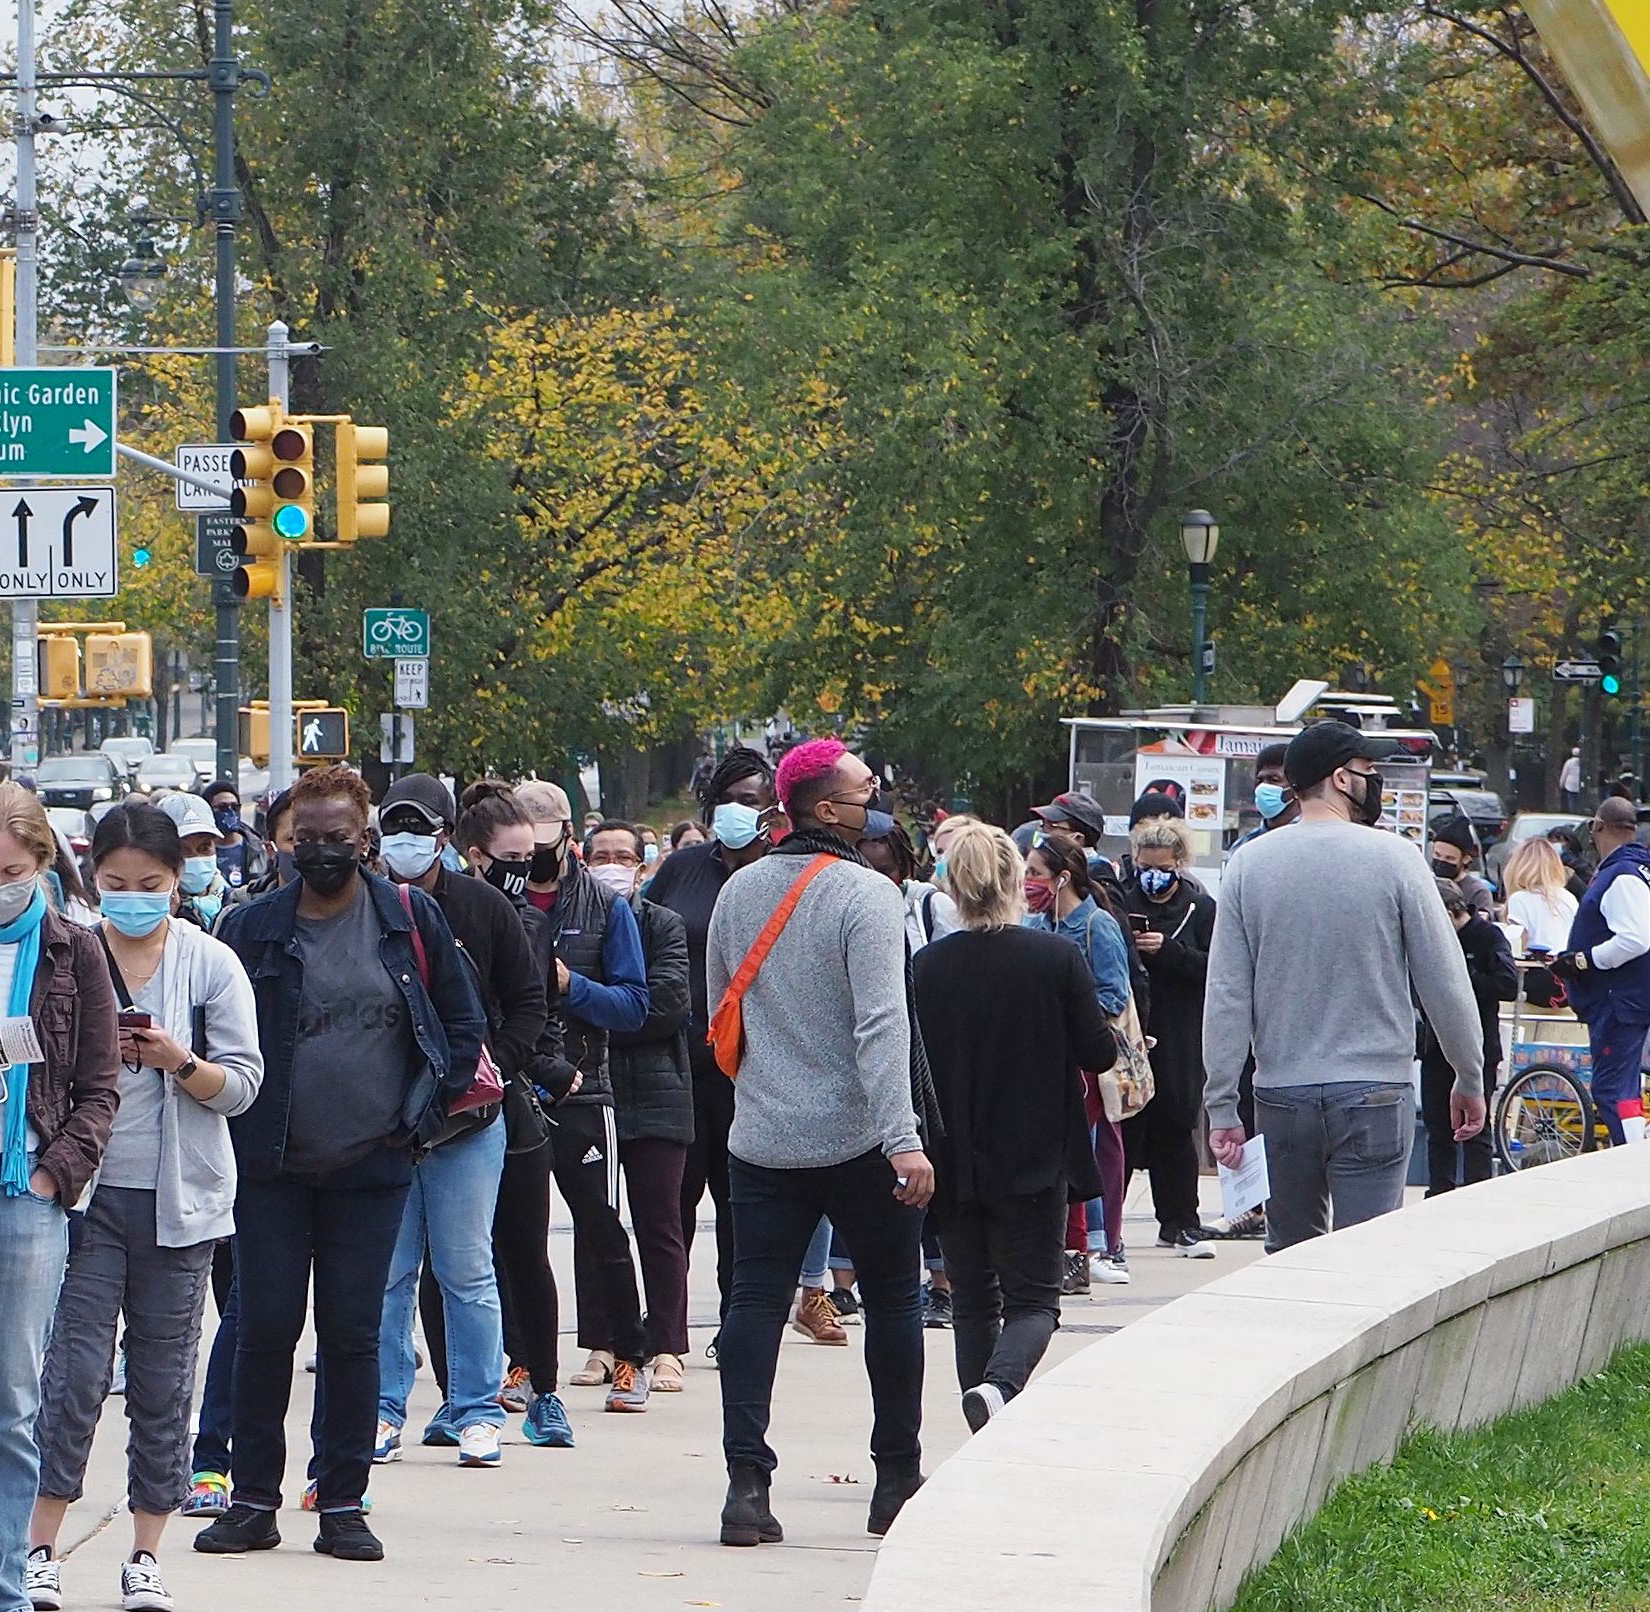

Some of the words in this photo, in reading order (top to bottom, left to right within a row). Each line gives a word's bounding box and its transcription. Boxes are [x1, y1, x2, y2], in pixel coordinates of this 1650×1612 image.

[28, 383, 99, 405] Garden
[184, 454, 228, 473] PASSE
[207, 517, 246, 525] EASTERN
[206, 528, 233, 537] PARK
[0, 573, 47, 589] ONLY
[58, 572, 107, 588] ONLY
[395, 644, 423, 654] ROUTE
[400, 664, 423, 675] KEEP
[1144, 761, 1188, 772] Jamaican
